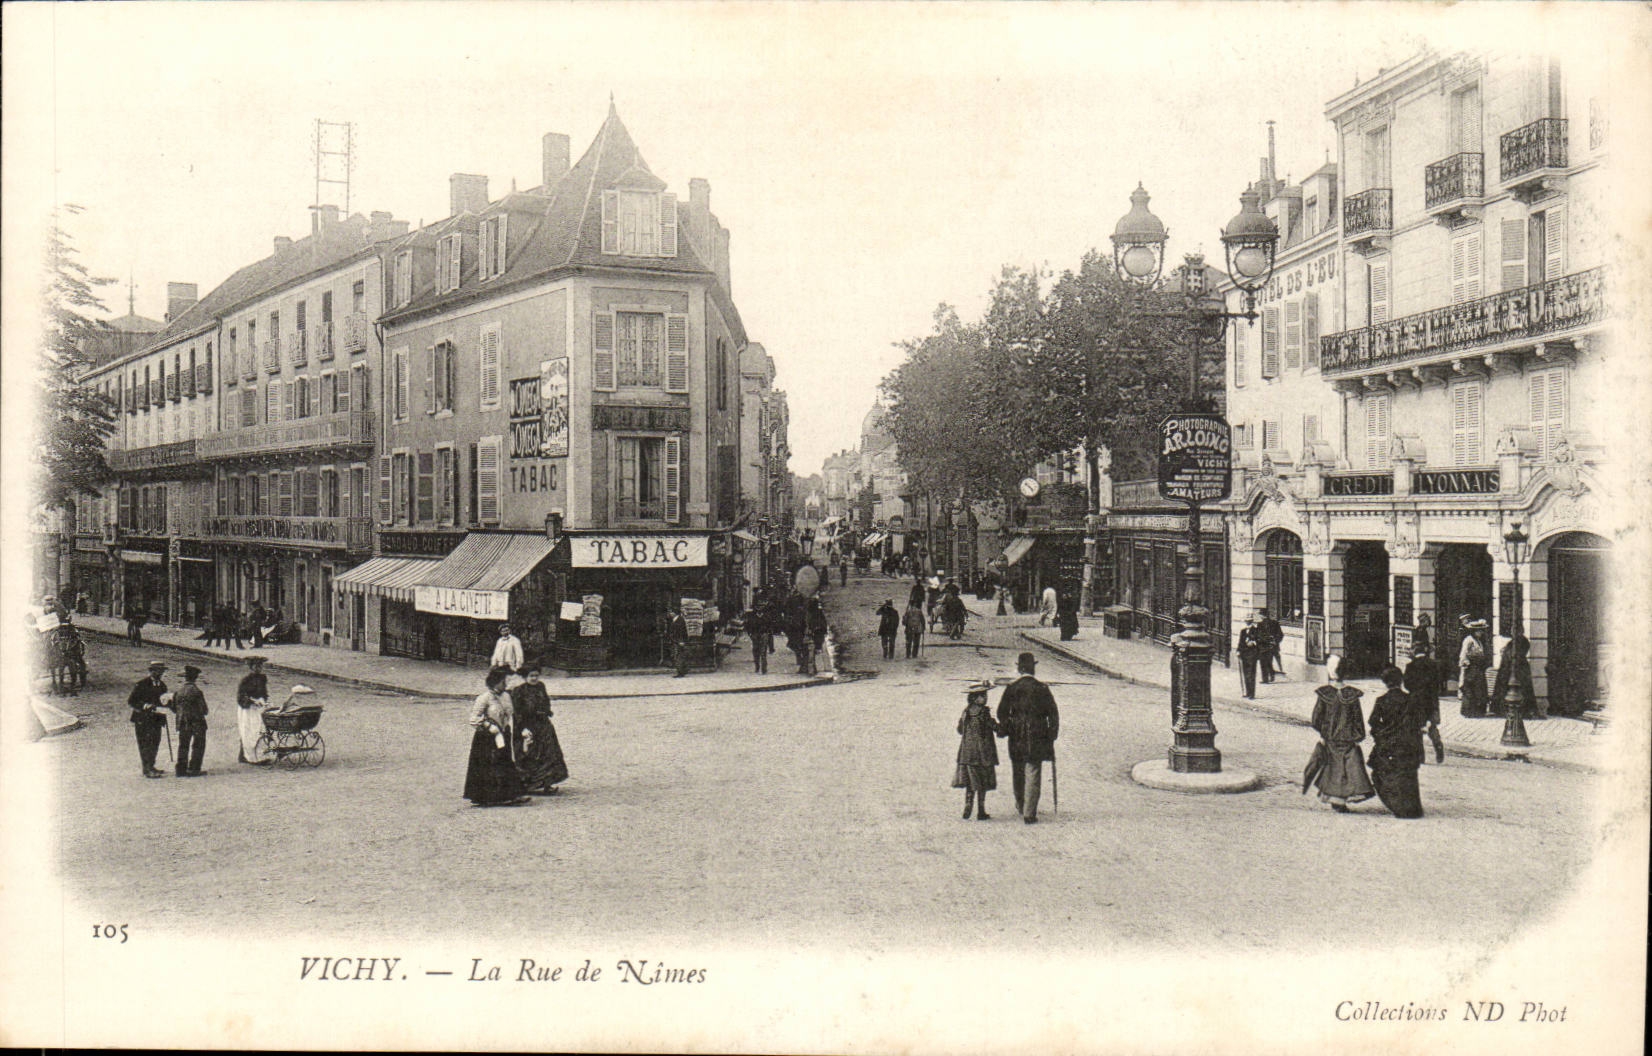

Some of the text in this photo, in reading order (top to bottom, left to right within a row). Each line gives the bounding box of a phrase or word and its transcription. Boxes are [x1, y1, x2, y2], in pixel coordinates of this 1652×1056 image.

[1287, 269, 1302, 296] DE
[515, 422, 541, 457] OMEGA
[1163, 418, 1229, 438] PHOTOGRAPHIE
[1162, 430, 1229, 455] ARLOING
[1197, 459, 1229, 468] VICHY
[510, 464, 558, 493] TABAC
[1330, 472, 1500, 495] CREDIT LYONNAIS
[1168, 488, 1222, 500] AMATEURS
[590, 540, 689, 564] TABAC
[436, 589, 441, 609] A
[444, 590, 457, 611] LA
